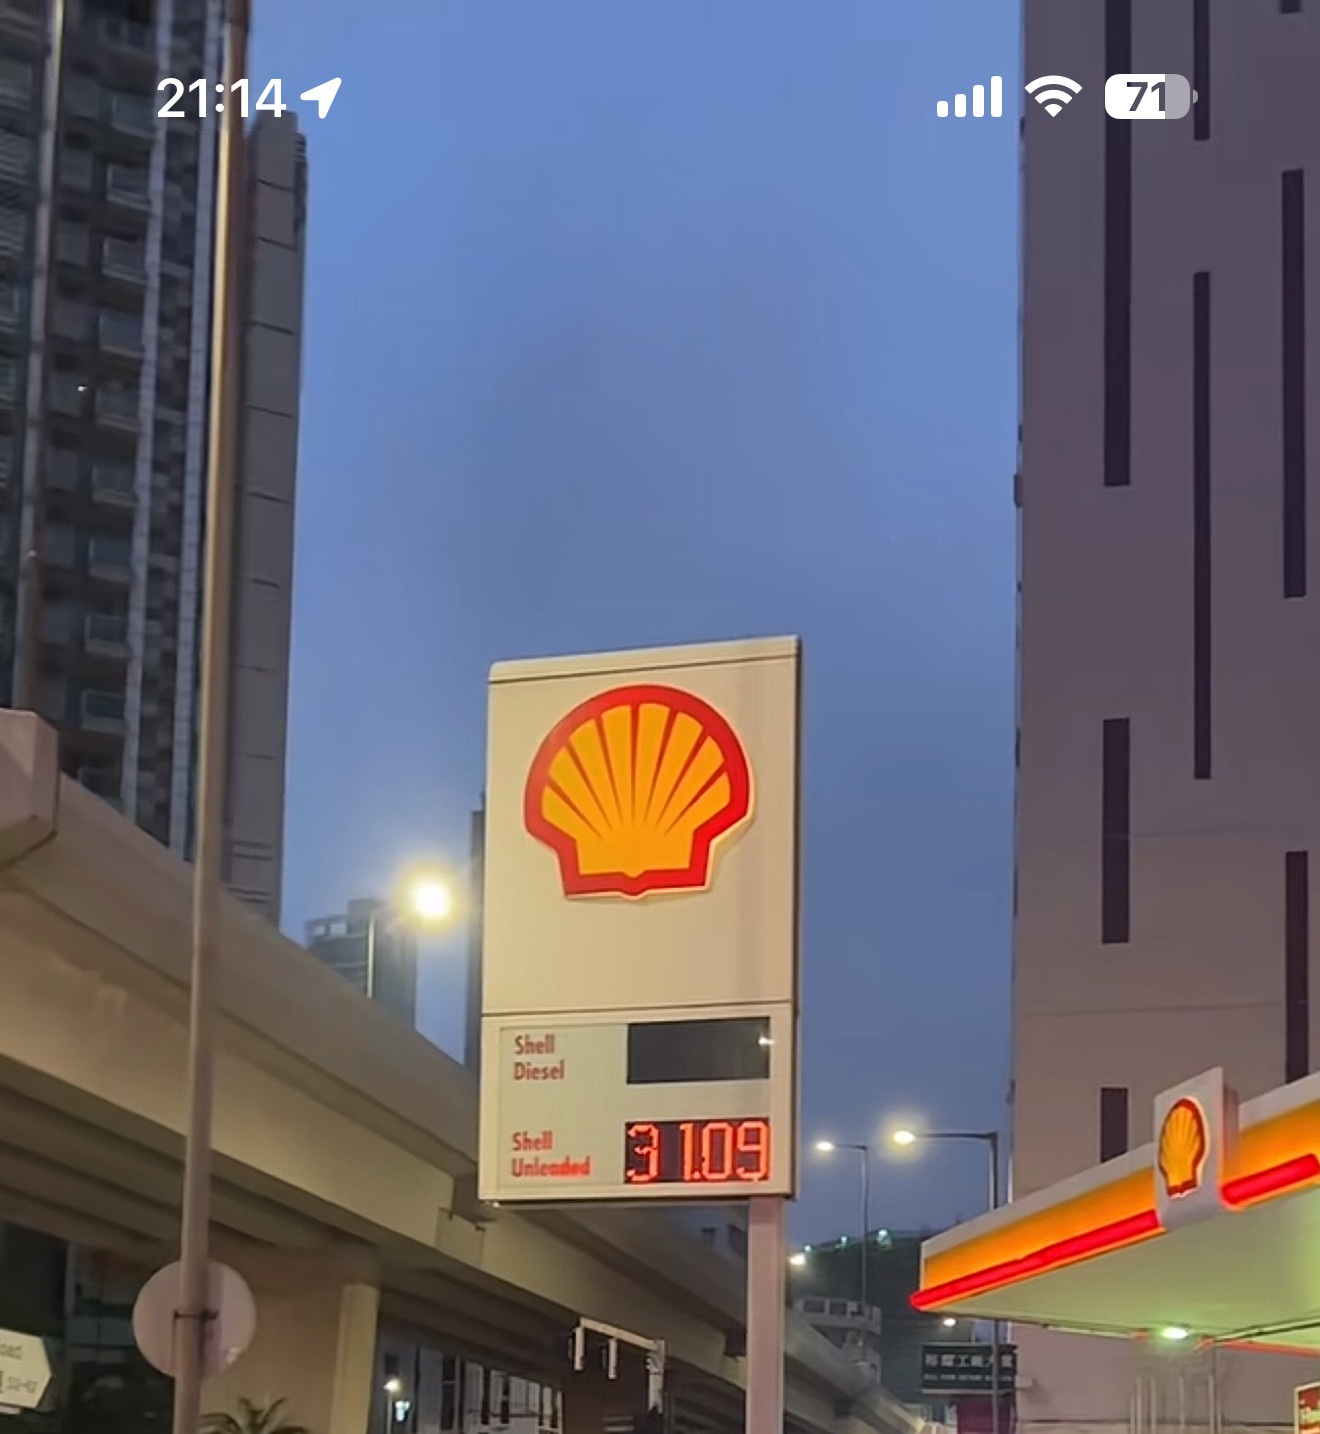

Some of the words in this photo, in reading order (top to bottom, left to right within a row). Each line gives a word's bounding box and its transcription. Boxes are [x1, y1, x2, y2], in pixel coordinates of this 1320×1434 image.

[514, 1034, 555, 1055] Shell
[513, 1060, 565, 1081] Diesel
[512, 1130, 553, 1152] Shell
[626, 1121, 769, 1183] 31.09
[511, 1155, 591, 1178] Unleaded
